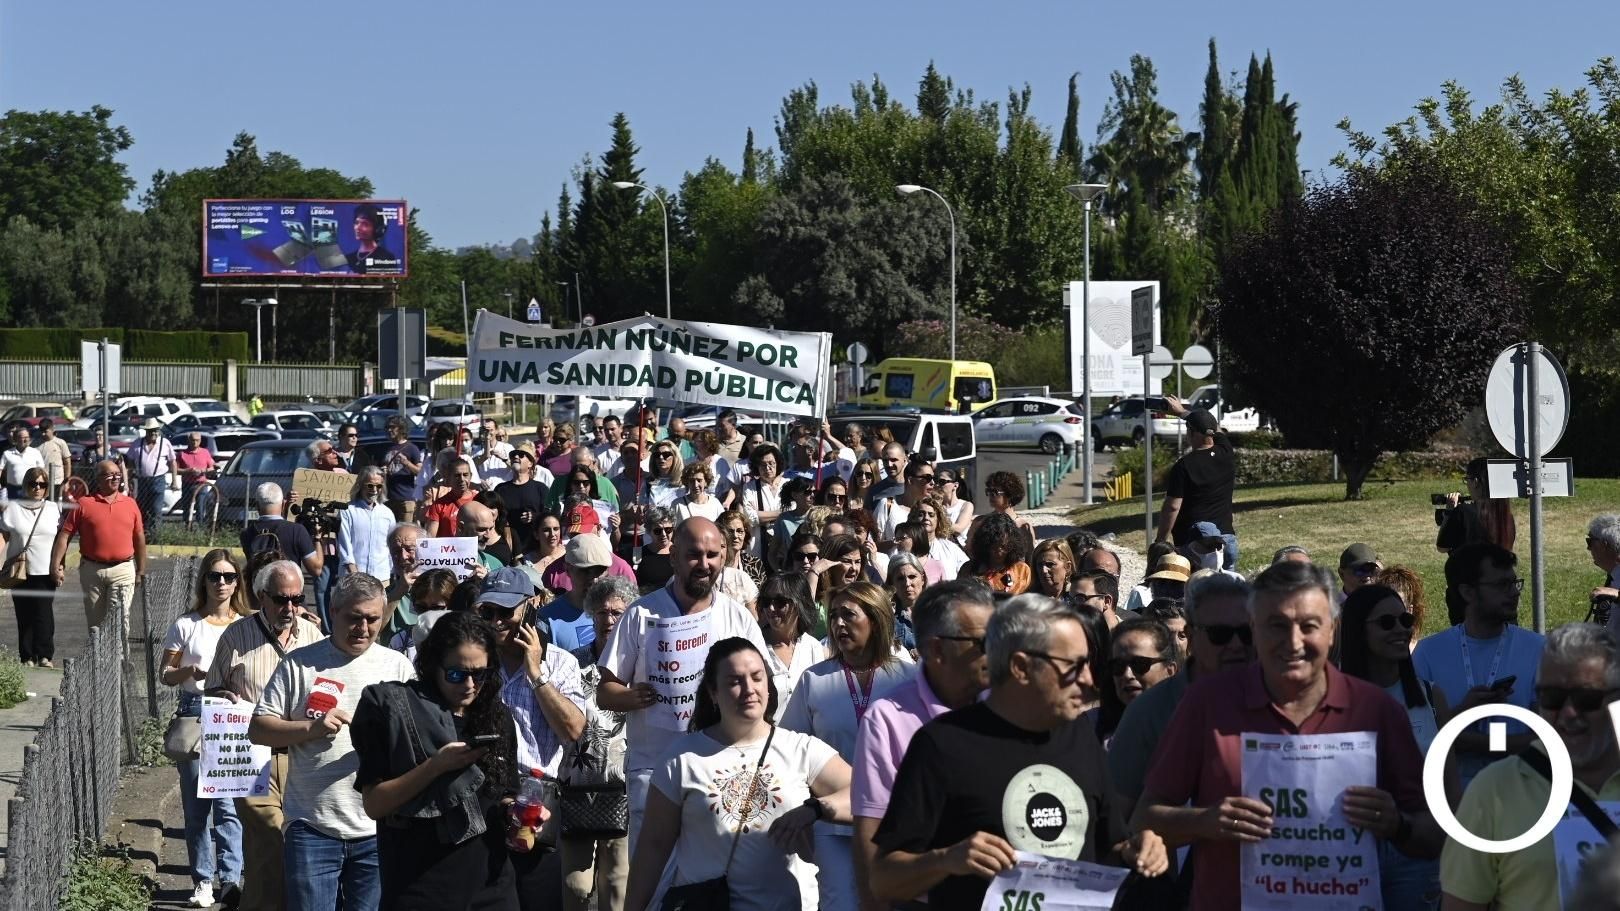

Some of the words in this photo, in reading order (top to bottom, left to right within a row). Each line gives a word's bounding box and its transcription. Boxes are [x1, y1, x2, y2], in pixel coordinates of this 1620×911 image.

[625, 323, 729, 360] NÚÑEZ
[737, 340, 798, 369] POR
[479, 359, 540, 383] UNA
[546, 362, 677, 389] SANIDAD
[684, 366, 815, 406] PÚBLICA
[1023, 403, 1039, 413] 092
[440, 545, 456, 554] YA!
[657, 640, 672, 653] Sr.
[675, 632, 708, 652] Gerente
[658, 660, 680, 672] NO
[648, 674, 670, 684] más
[213, 713, 224, 723] Sr.
[205, 733, 220, 741] SIN
[219, 745, 231, 753] NO
[235, 745, 252, 753] HAY
[217, 757, 252, 765] CALIDAD
[207, 769, 262, 778] ASISTENCIAL
[1259, 787, 1308, 818] SAS
[1031, 806, 1062, 818] JACK&
[1031, 816, 1062, 828] JONES
[1262, 823, 1345, 841] scucha
[1261, 853, 1330, 872] rompe
[1336, 855, 1363, 872] ya
